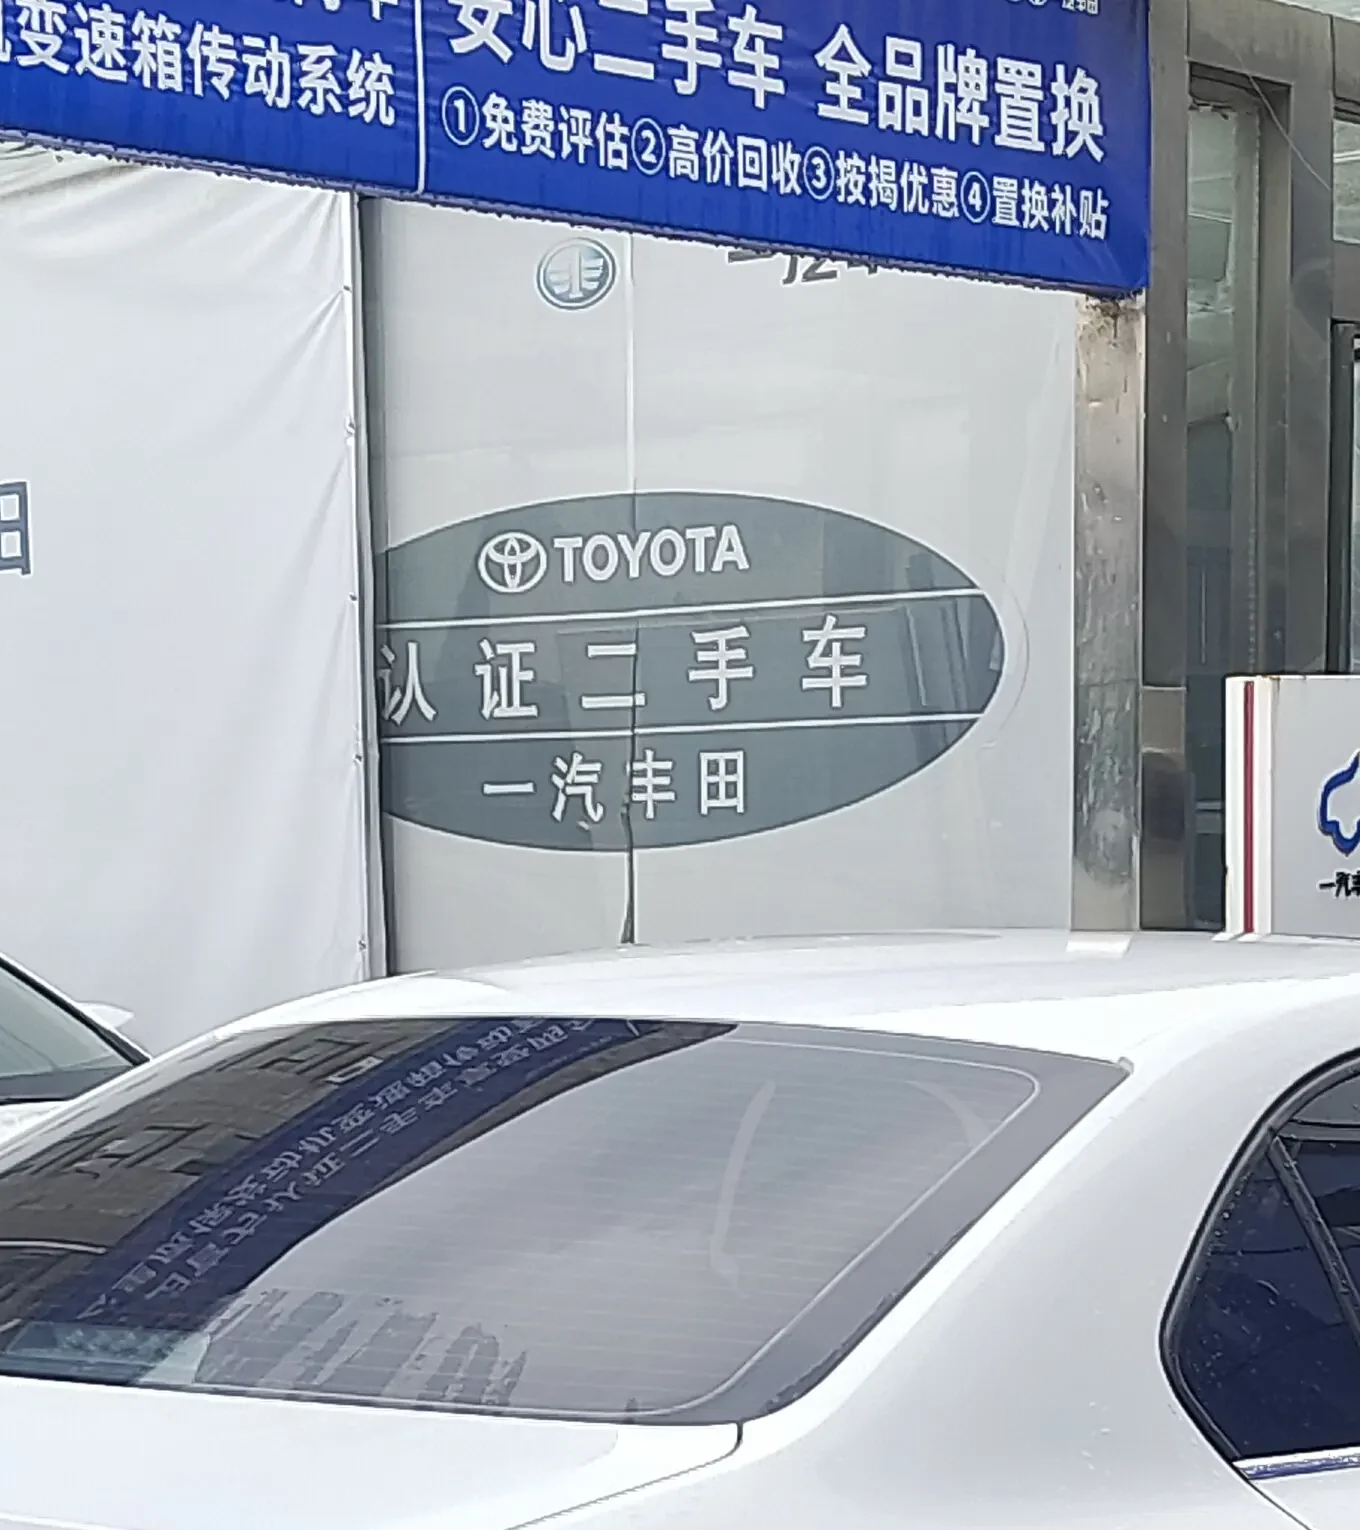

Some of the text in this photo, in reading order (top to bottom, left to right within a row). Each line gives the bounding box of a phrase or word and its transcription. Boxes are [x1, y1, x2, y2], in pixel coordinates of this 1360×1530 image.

[814, 23, 1106, 163] 全品牌置换
[552, 524, 750, 583] TOYOTA
[378, 614, 869, 725] 认证二手车
[482, 750, 747, 824] 一汽丰田
